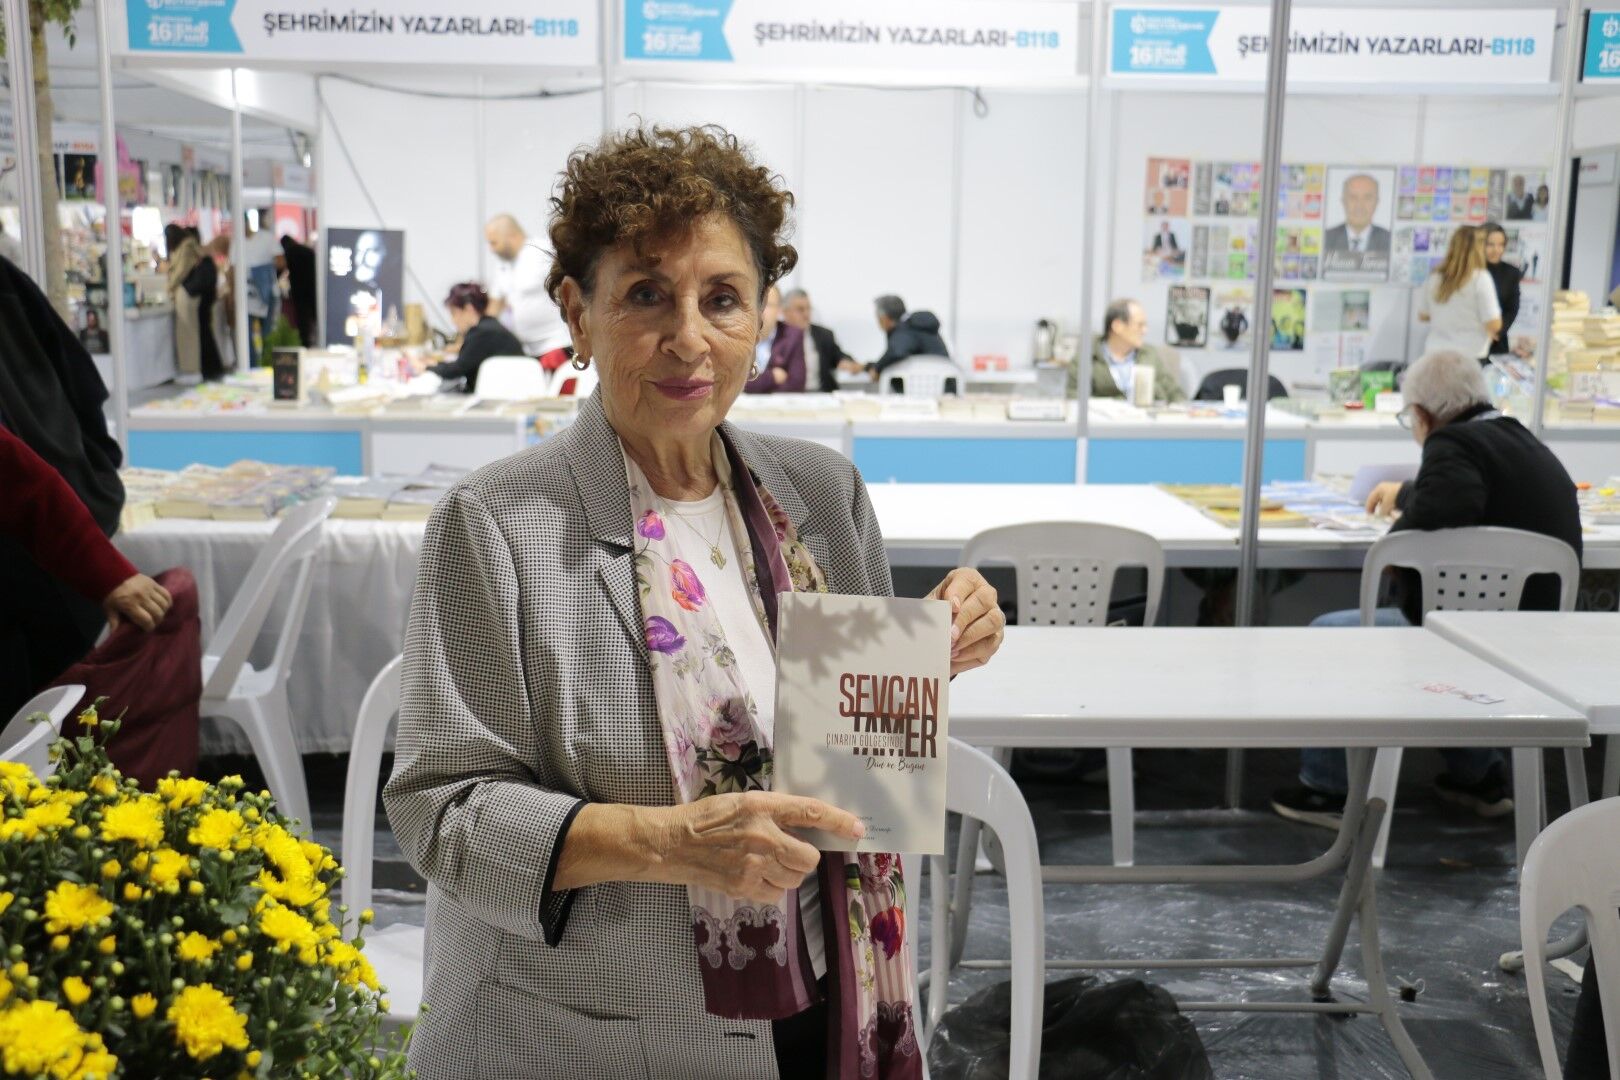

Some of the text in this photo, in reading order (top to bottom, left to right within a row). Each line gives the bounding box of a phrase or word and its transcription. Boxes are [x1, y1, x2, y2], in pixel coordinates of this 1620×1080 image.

[263, 9, 578, 38] ŞEHRİMİZİN YAZARLARI-B118
[754, 20, 1059, 49] ŞEHRİMİZİN YAZARLARI-B118
[1366, 36, 1535, 56] YAZARLARI-B118
[839, 672, 939, 720] SEVCAN
[826, 733, 857, 748] ÇINARIN
